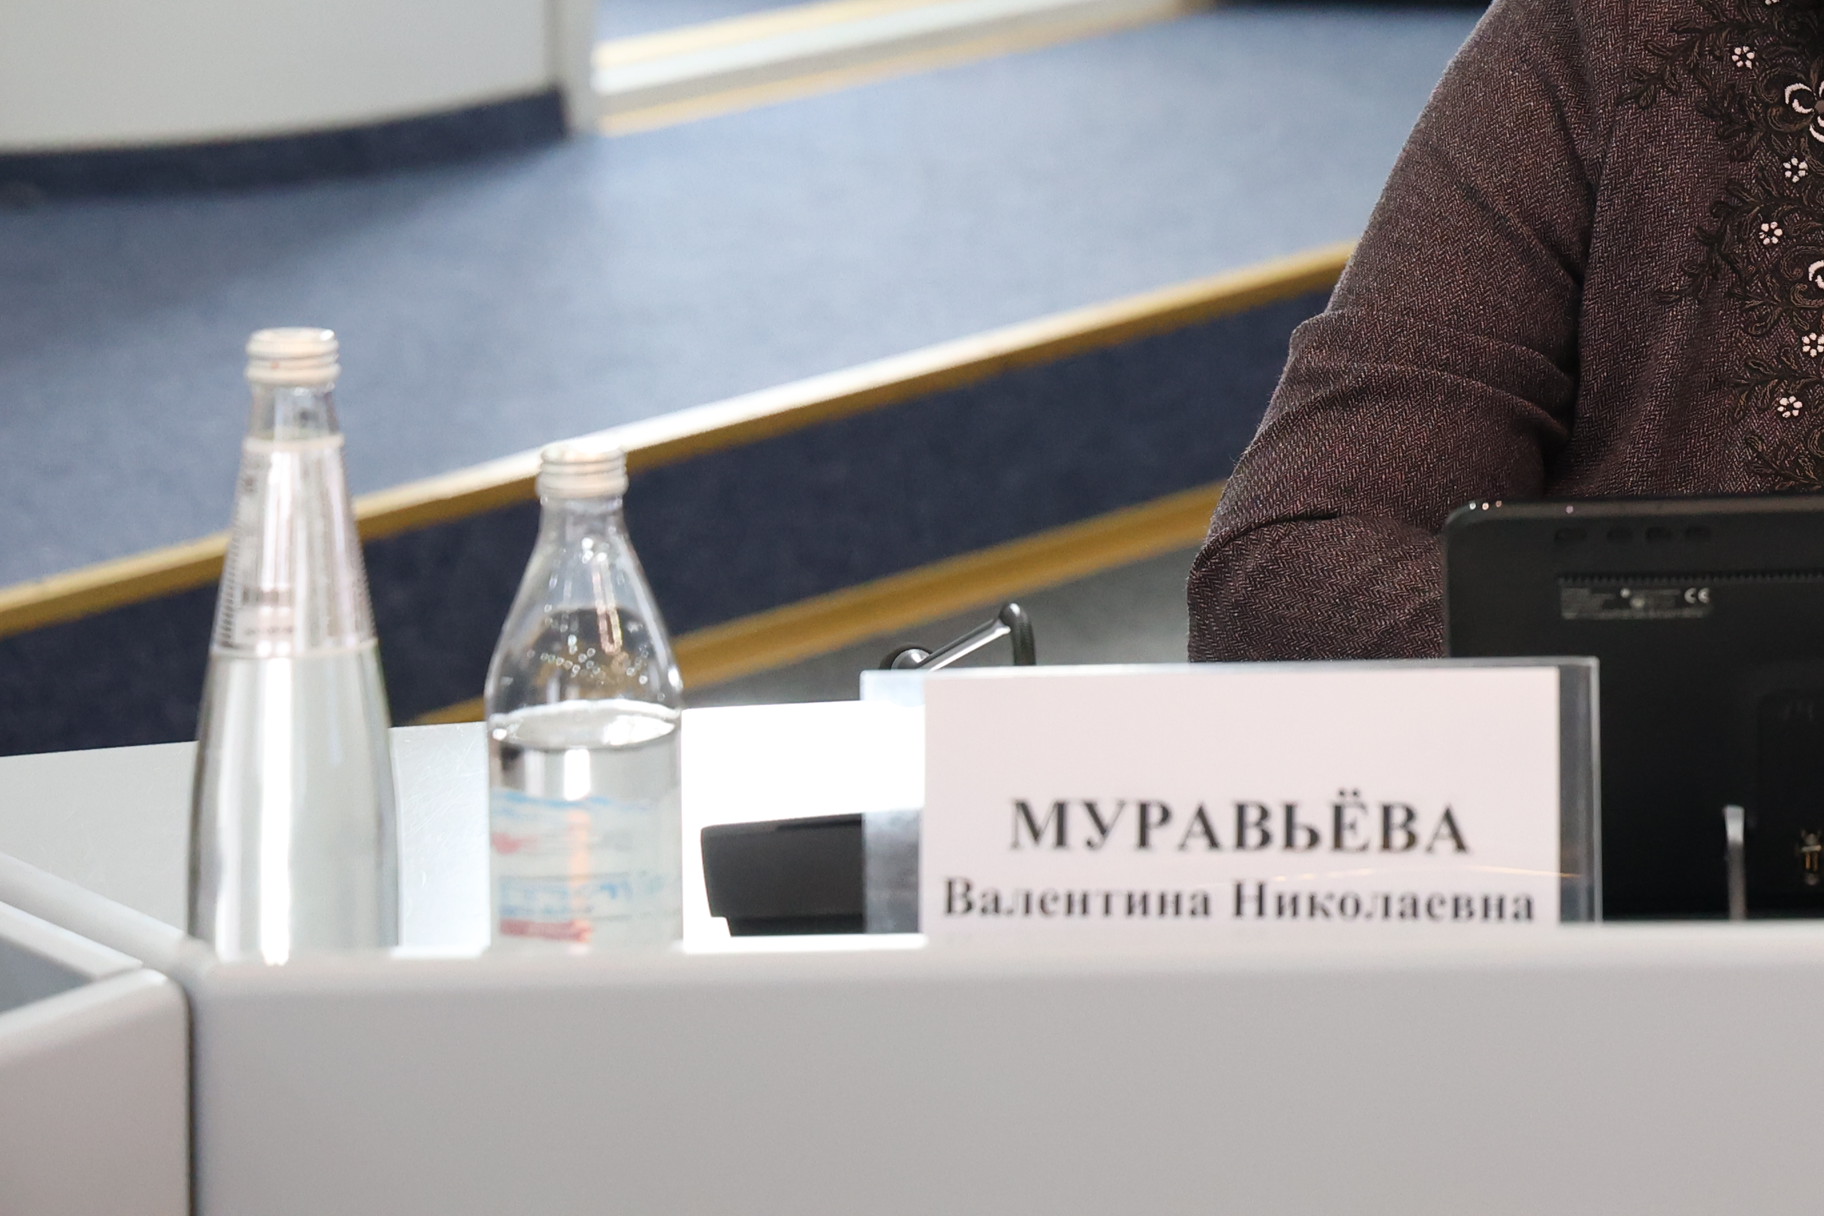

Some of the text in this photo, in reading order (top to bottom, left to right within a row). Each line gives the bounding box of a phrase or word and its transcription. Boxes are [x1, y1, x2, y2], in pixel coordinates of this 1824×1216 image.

[1009, 787, 1471, 855] МУРАВЬЁВА
[943, 877, 1535, 923] Валентина Николаевна
